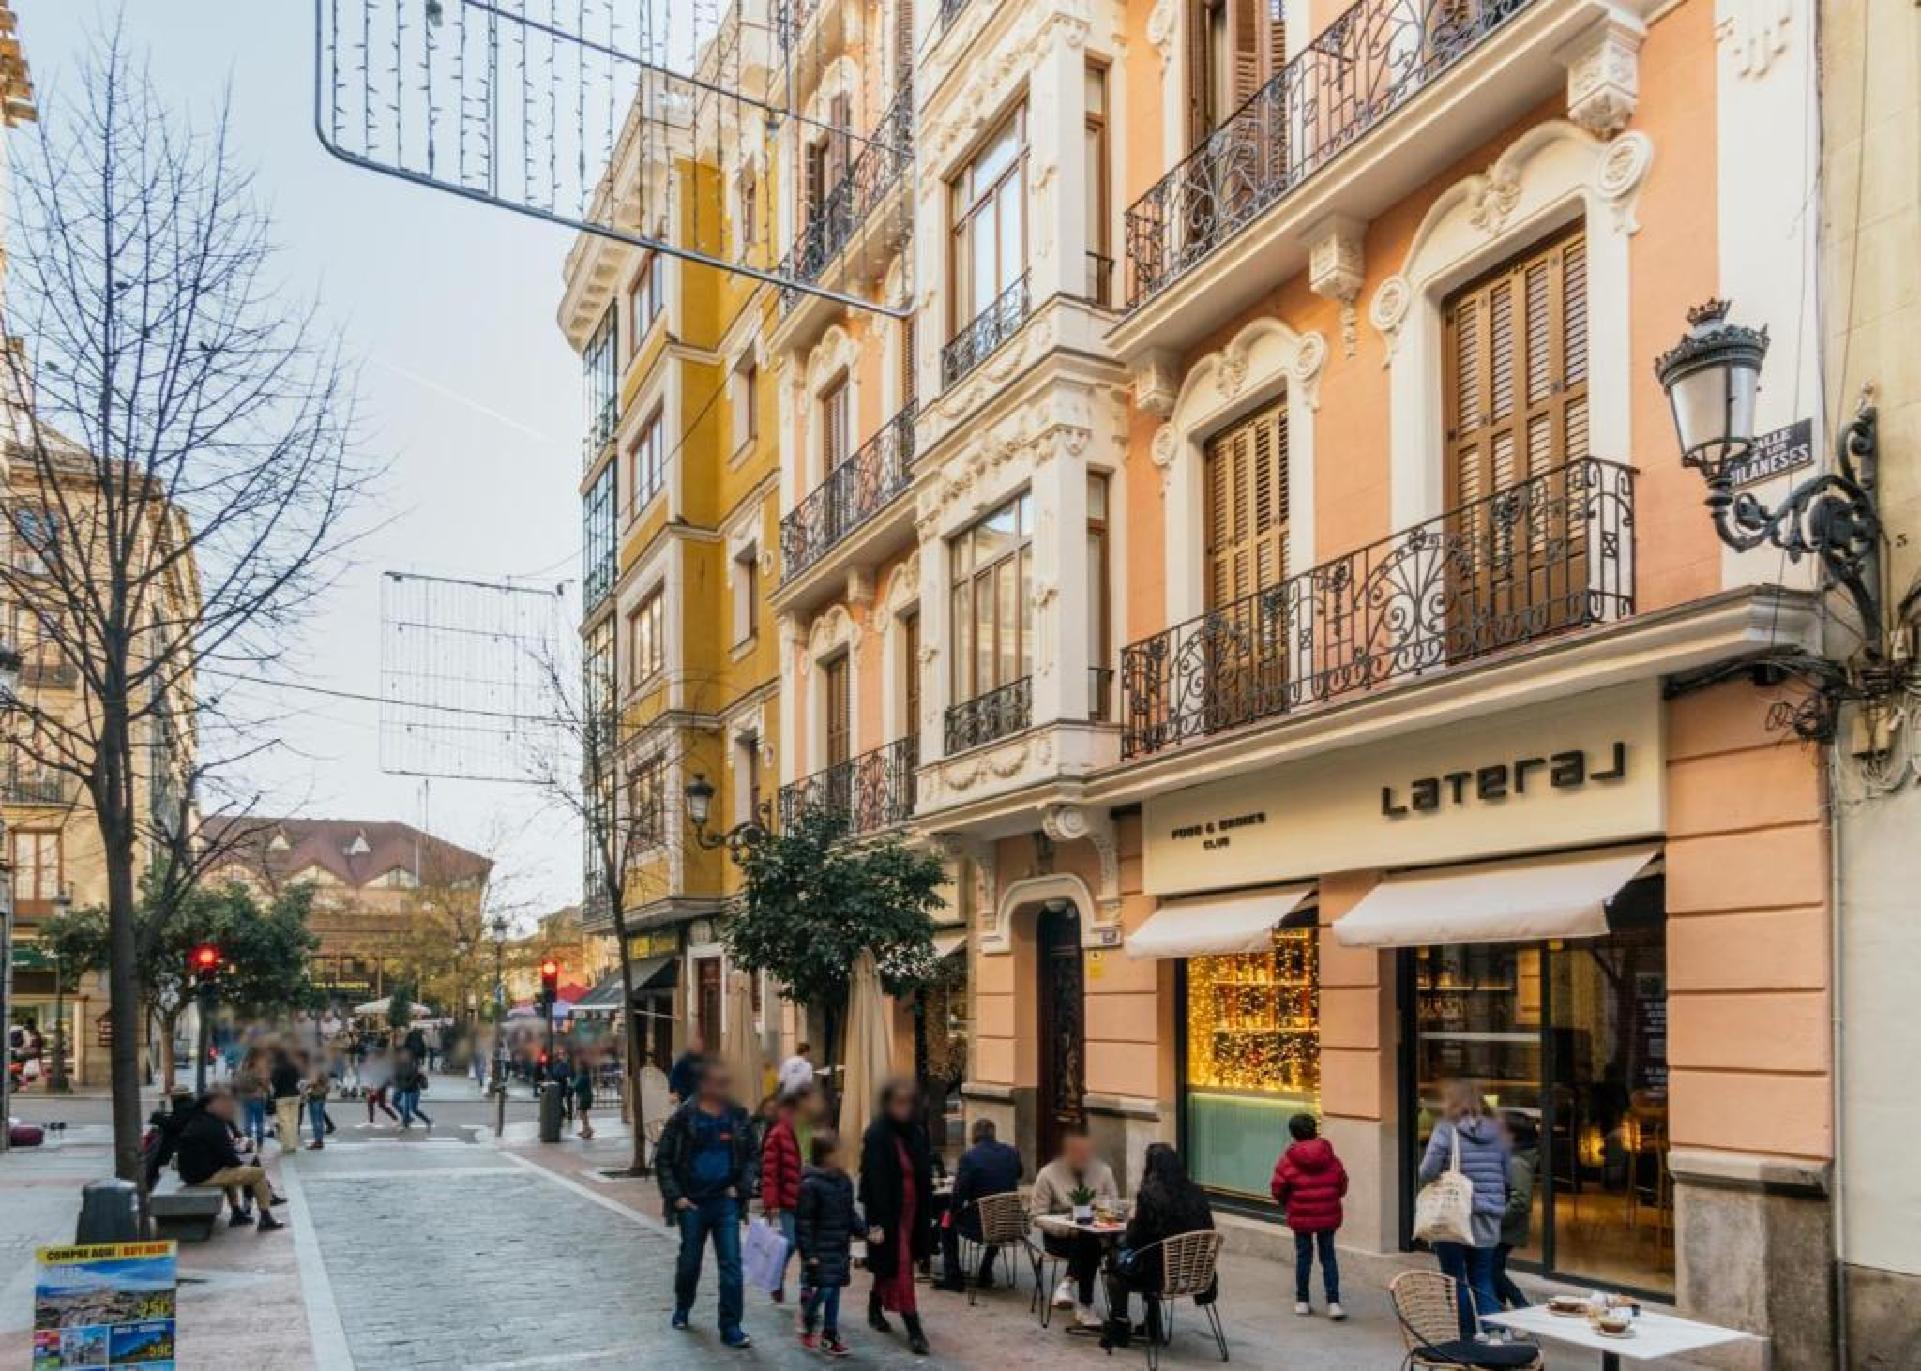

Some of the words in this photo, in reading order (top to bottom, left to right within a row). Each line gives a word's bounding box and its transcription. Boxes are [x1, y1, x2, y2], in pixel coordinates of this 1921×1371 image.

[1172, 825, 1202, 840] FOOD
[1203, 836, 1230, 850] CLUB
[46, 1248, 89, 1261] COMPRE
